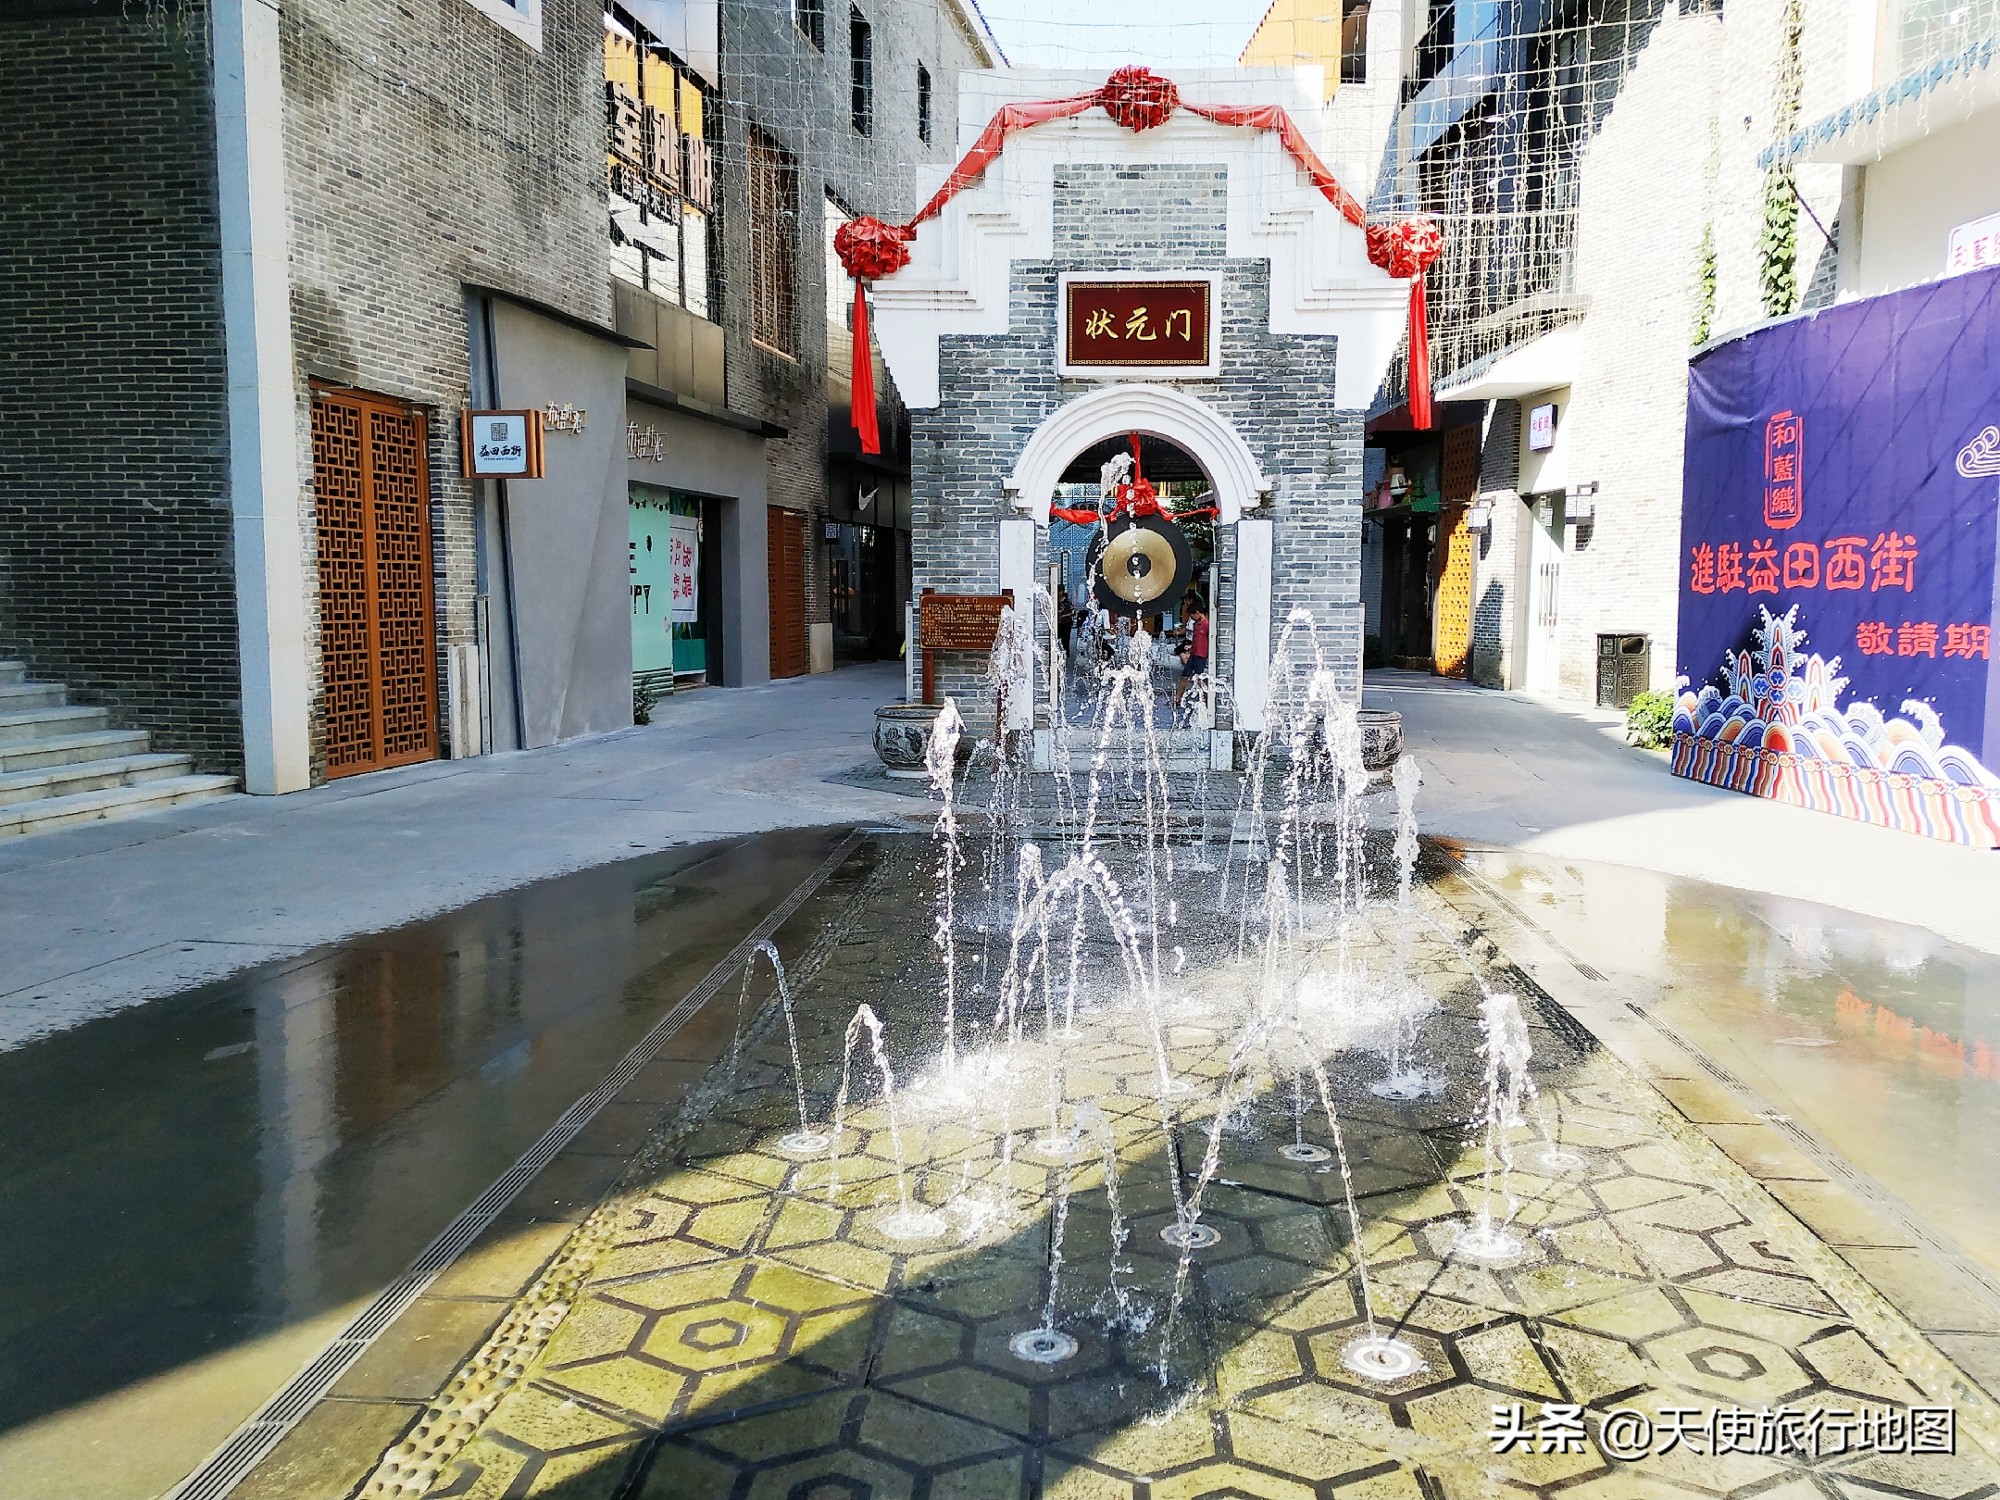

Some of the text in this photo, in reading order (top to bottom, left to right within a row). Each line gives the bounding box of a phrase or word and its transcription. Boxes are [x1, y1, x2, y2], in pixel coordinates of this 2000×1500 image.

[1085, 306, 1191, 342] 状元门
[479, 444, 522, 458] 益田西街
[1771, 423, 1796, 514] 和藍織
[682, 544, 692, 598] 招聘
[1690, 531, 1918, 595] 進駐益田西街
[1856, 621, 1991, 660] 敬請期
